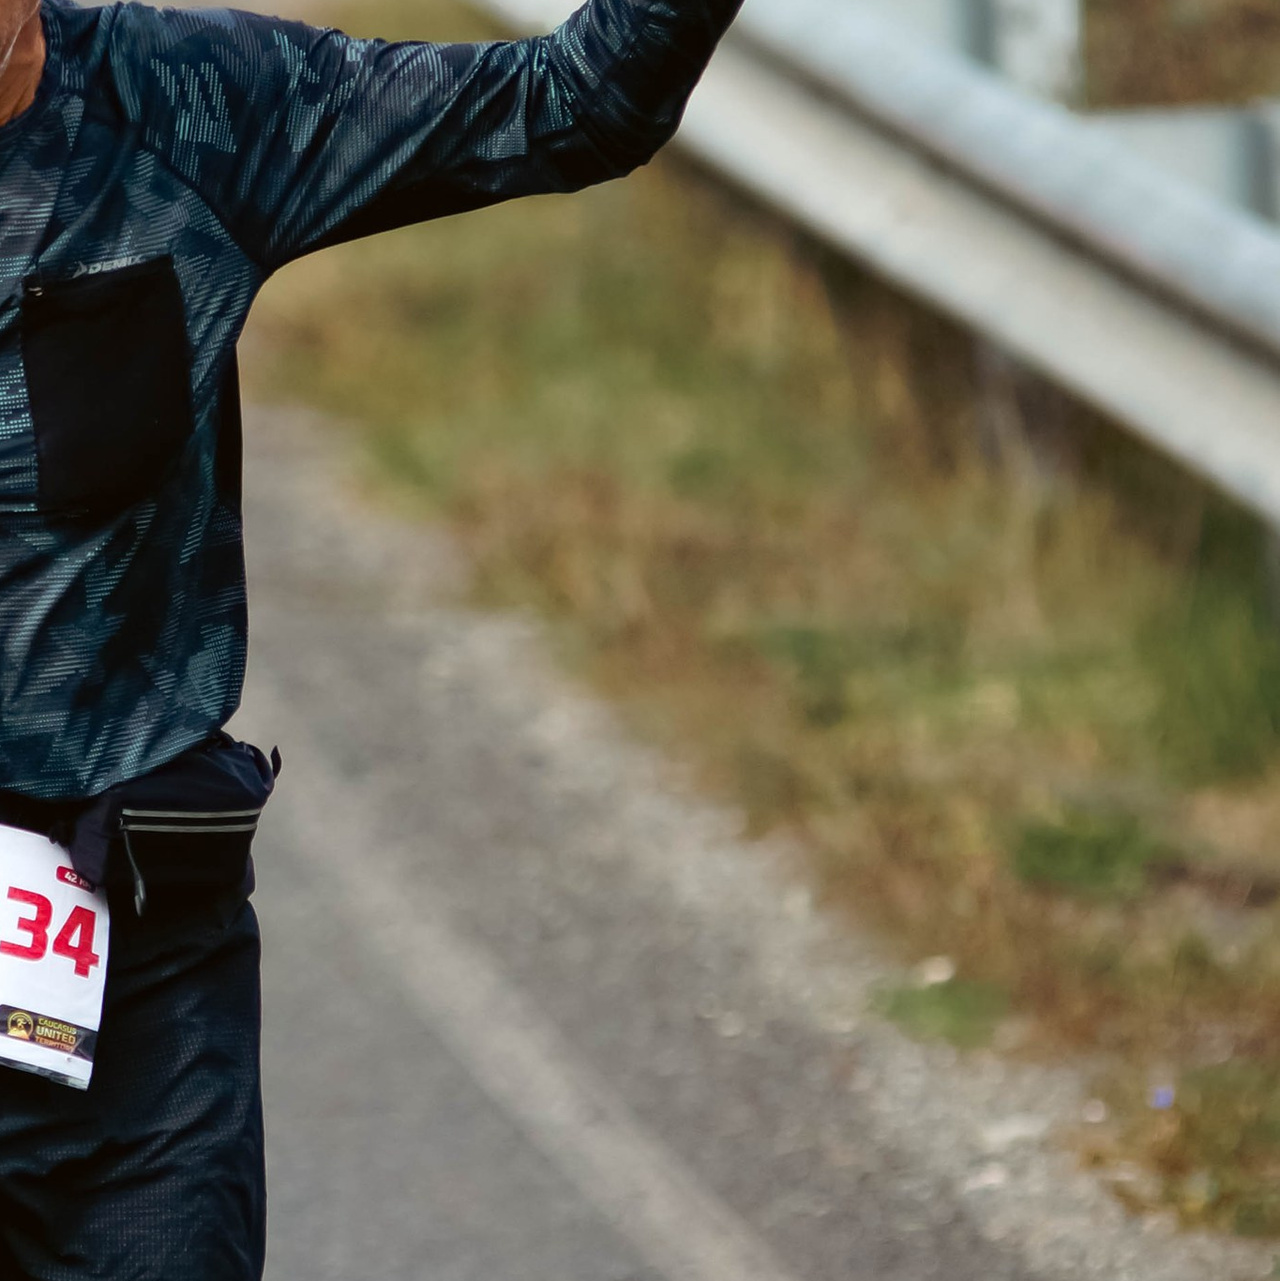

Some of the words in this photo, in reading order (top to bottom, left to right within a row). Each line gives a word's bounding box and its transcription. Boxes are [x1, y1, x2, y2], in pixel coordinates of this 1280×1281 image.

[87, 254, 145, 275] DEMIX
[64, 871, 78, 884] 42
[36, 1026, 76, 1045] UNITED
[38, 1018, 77, 1035] CAUCASUS
